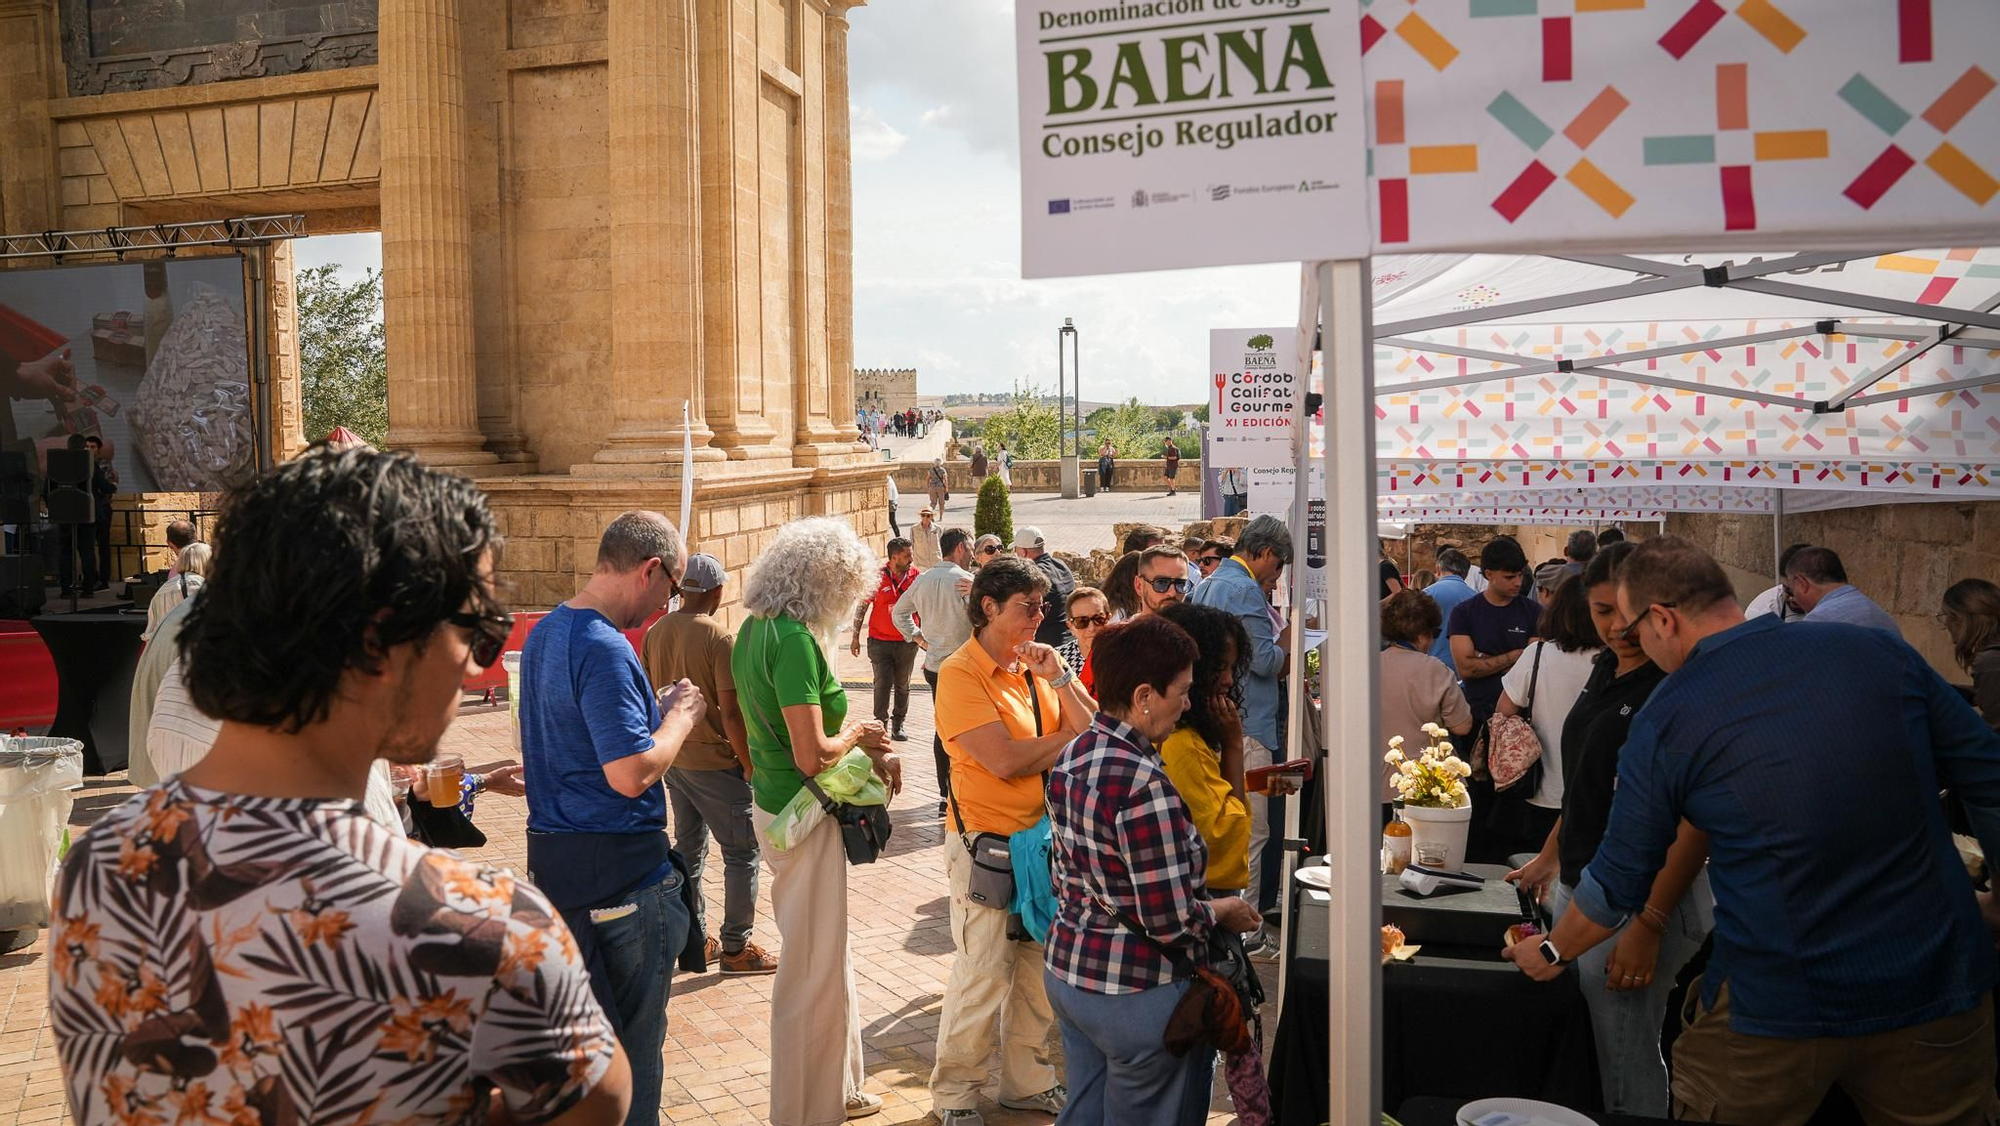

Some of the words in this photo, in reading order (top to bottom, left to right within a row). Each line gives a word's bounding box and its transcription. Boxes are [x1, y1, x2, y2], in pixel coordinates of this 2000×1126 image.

[1043, 23, 1335, 116] BAENA
[1042, 123, 1164, 157] Consejo
[1176, 110, 1338, 149] Regulador
[1245, 357, 1276, 365] BAENA
[1232, 371, 1296, 384] Córdob
[1231, 385, 1296, 398] Califat
[1230, 402, 1293, 413] Gourme
[1226, 418, 1238, 427] XI
[1243, 416, 1291, 427] EDICIÓN
[1253, 467, 1280, 475] Consejo
